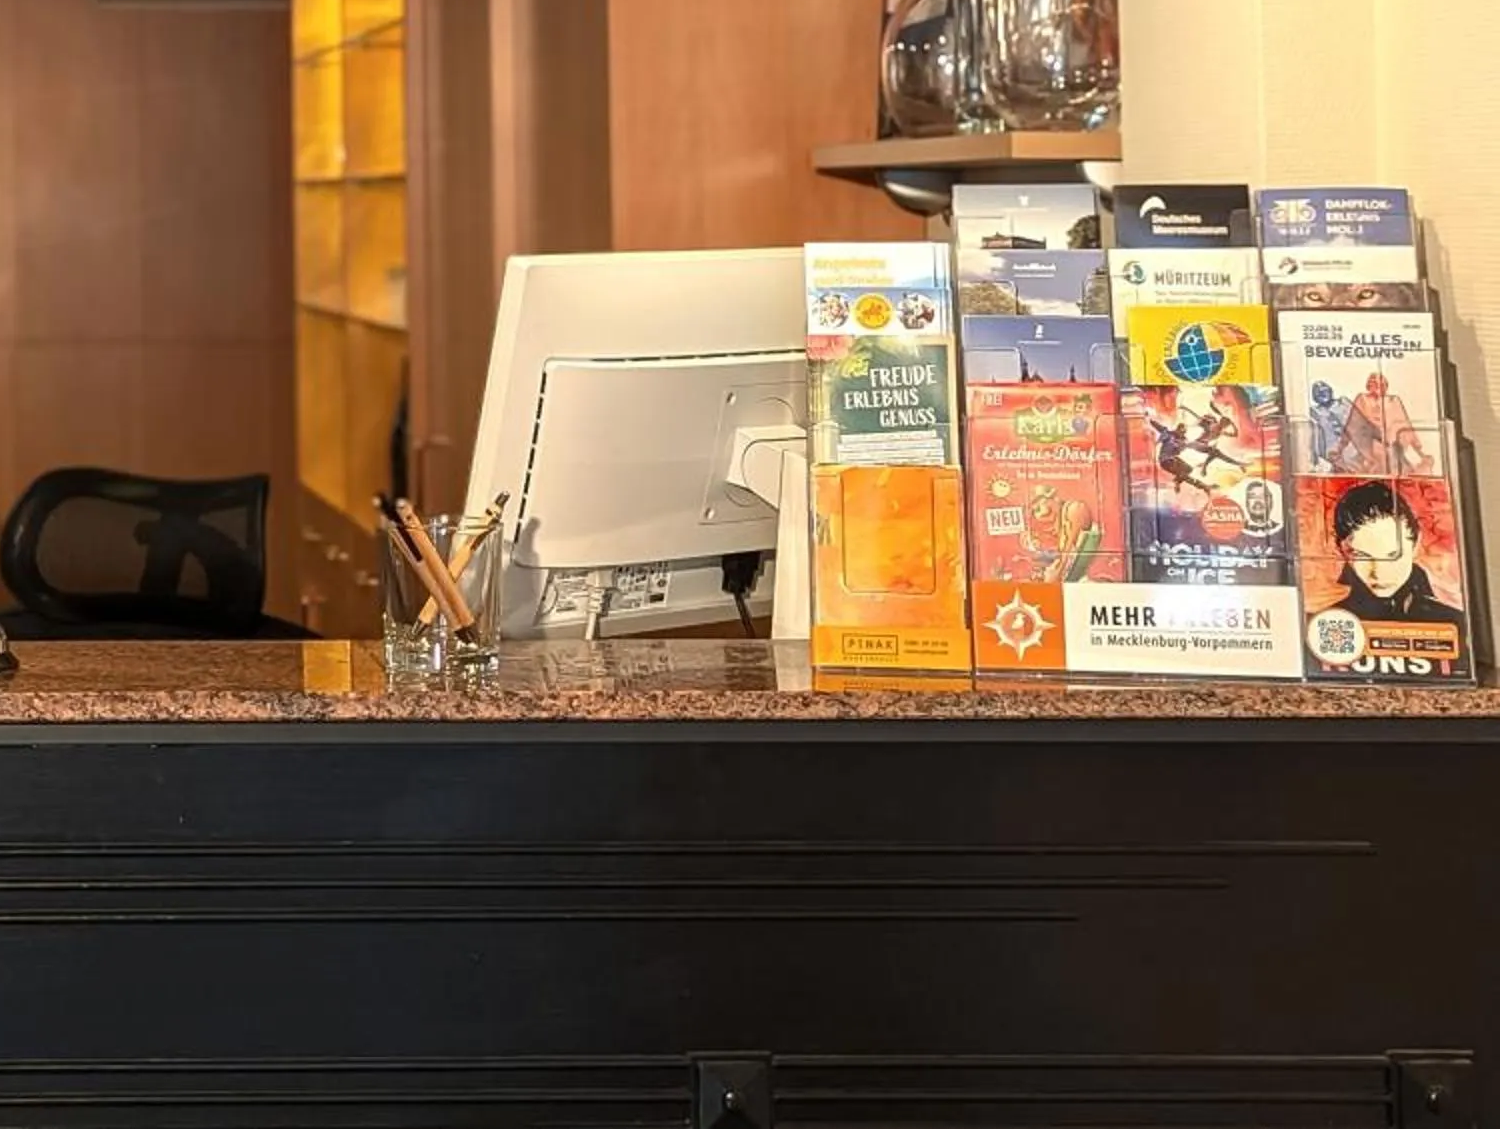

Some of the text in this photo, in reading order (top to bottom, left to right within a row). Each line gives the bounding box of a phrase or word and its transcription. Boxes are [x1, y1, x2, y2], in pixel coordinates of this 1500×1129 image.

[1154, 269, 1232, 287] MÜRITZEUM
[1349, 333, 1422, 352] ALLES IN
[1304, 345, 1405, 360] BEWEGUNG
[869, 364, 938, 388] FREUDE
[844, 388, 920, 410] ERLEBNIS
[879, 407, 937, 427] GENUSS
[1016, 413, 1075, 436] Karls
[990, 510, 1021, 527] NEU
[1203, 510, 1243, 522] SASHA
[1148, 540, 1273, 568] HOLIDAY
[1187, 568, 1237, 584] ICE
[1090, 606, 1272, 630] MEHR EBEN
[1091, 634, 1273, 651] in Mecklenburg-Vorpommern
[1321, 655, 1451, 676] UNS
